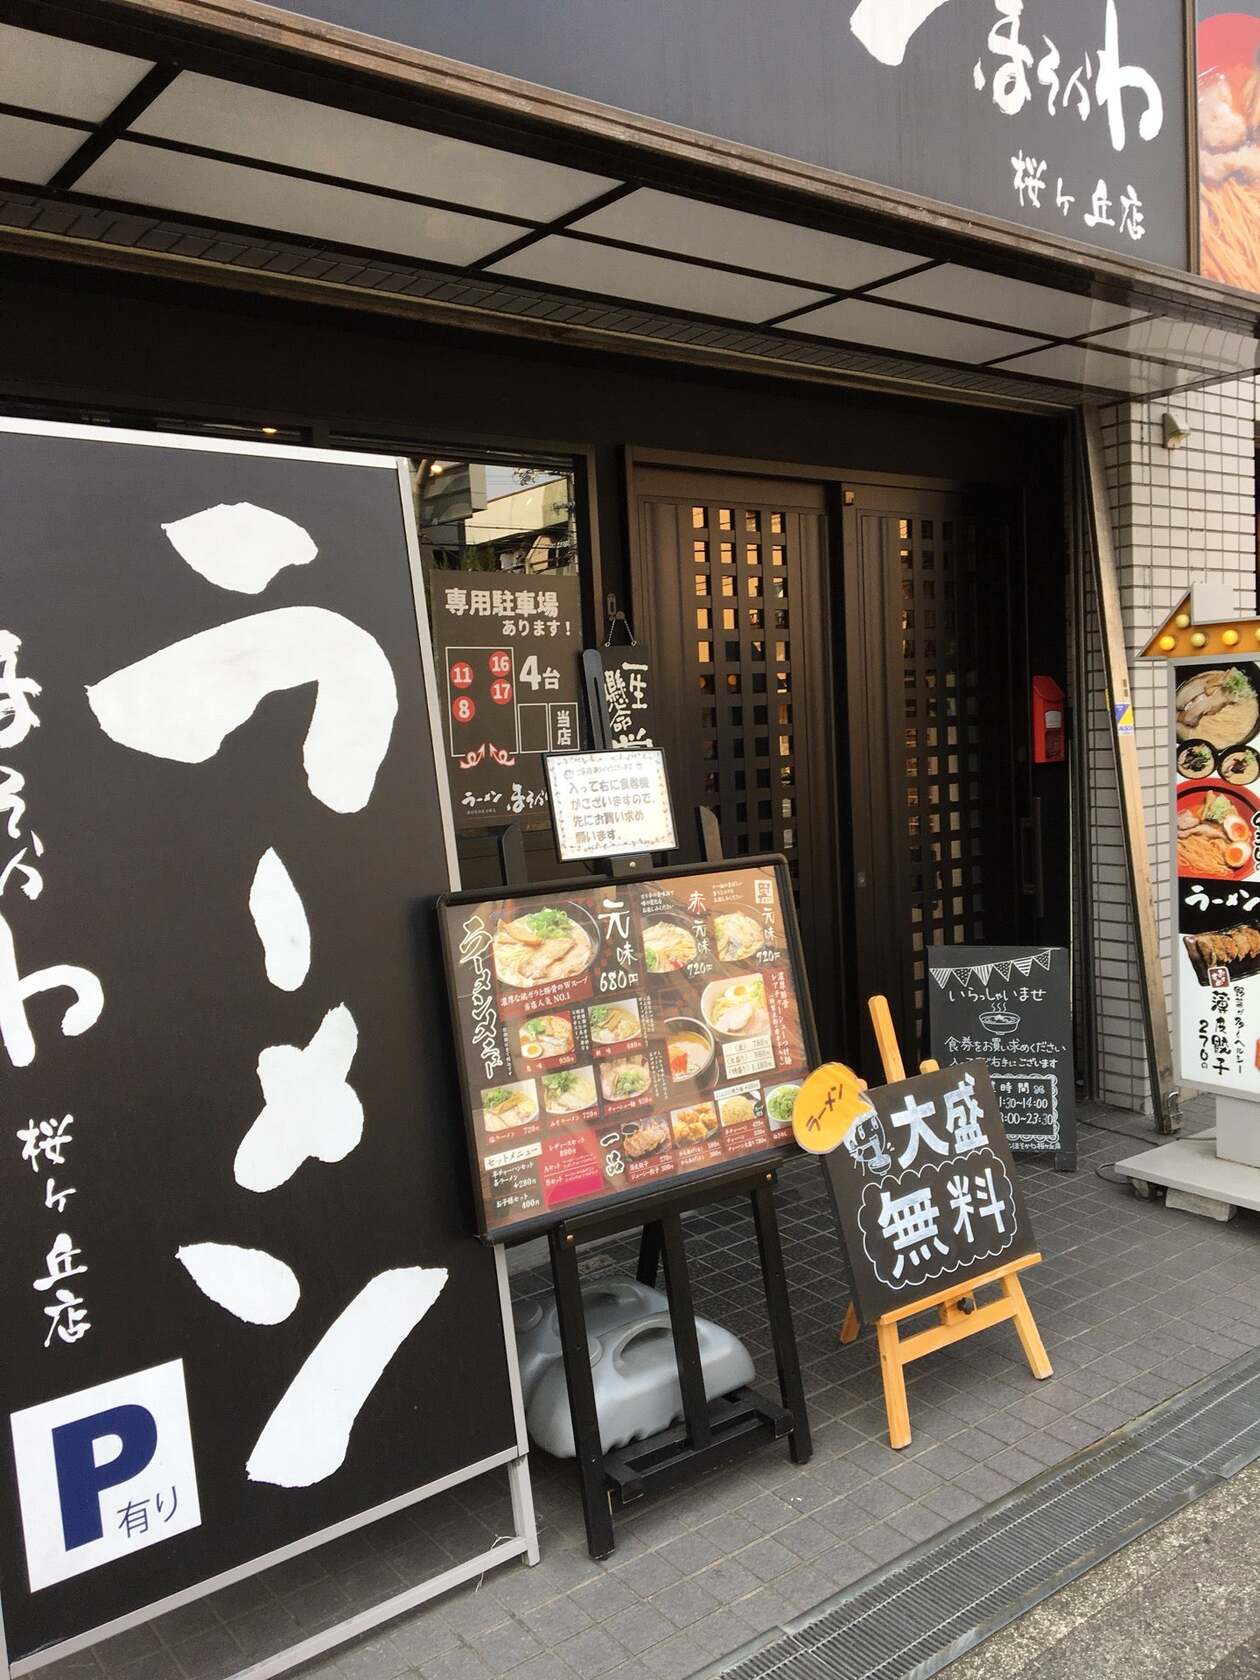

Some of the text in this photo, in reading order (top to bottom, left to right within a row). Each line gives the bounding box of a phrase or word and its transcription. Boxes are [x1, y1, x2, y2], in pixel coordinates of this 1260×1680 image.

[445, 588, 559, 618] 専用駐車場
[453, 666, 472, 684] 11
[491, 655, 510, 673] 16
[519, 655, 561, 691] 4台
[493, 683, 512, 700] 17
[459, 700, 470, 719] 8
[557, 710, 572, 746] 当店
[461, 790, 503, 807] ラーメン
[1184, 884, 1260, 912] ラーメン
[86, 501, 447, 1488] ラーメン
[600, 971, 640, 992] 680円
[948, 986, 1048, 1002] いらっしゃいませ
[805, 1083, 845, 1132] ラーメン
[889, 1072, 990, 1170] 大盛
[16, 1113, 92, 1348] 桜ヶ丘店
[878, 1167, 1006, 1279] 無料
[52, 1403, 158, 1552] P
[117, 1486, 178, 1539] 有り
